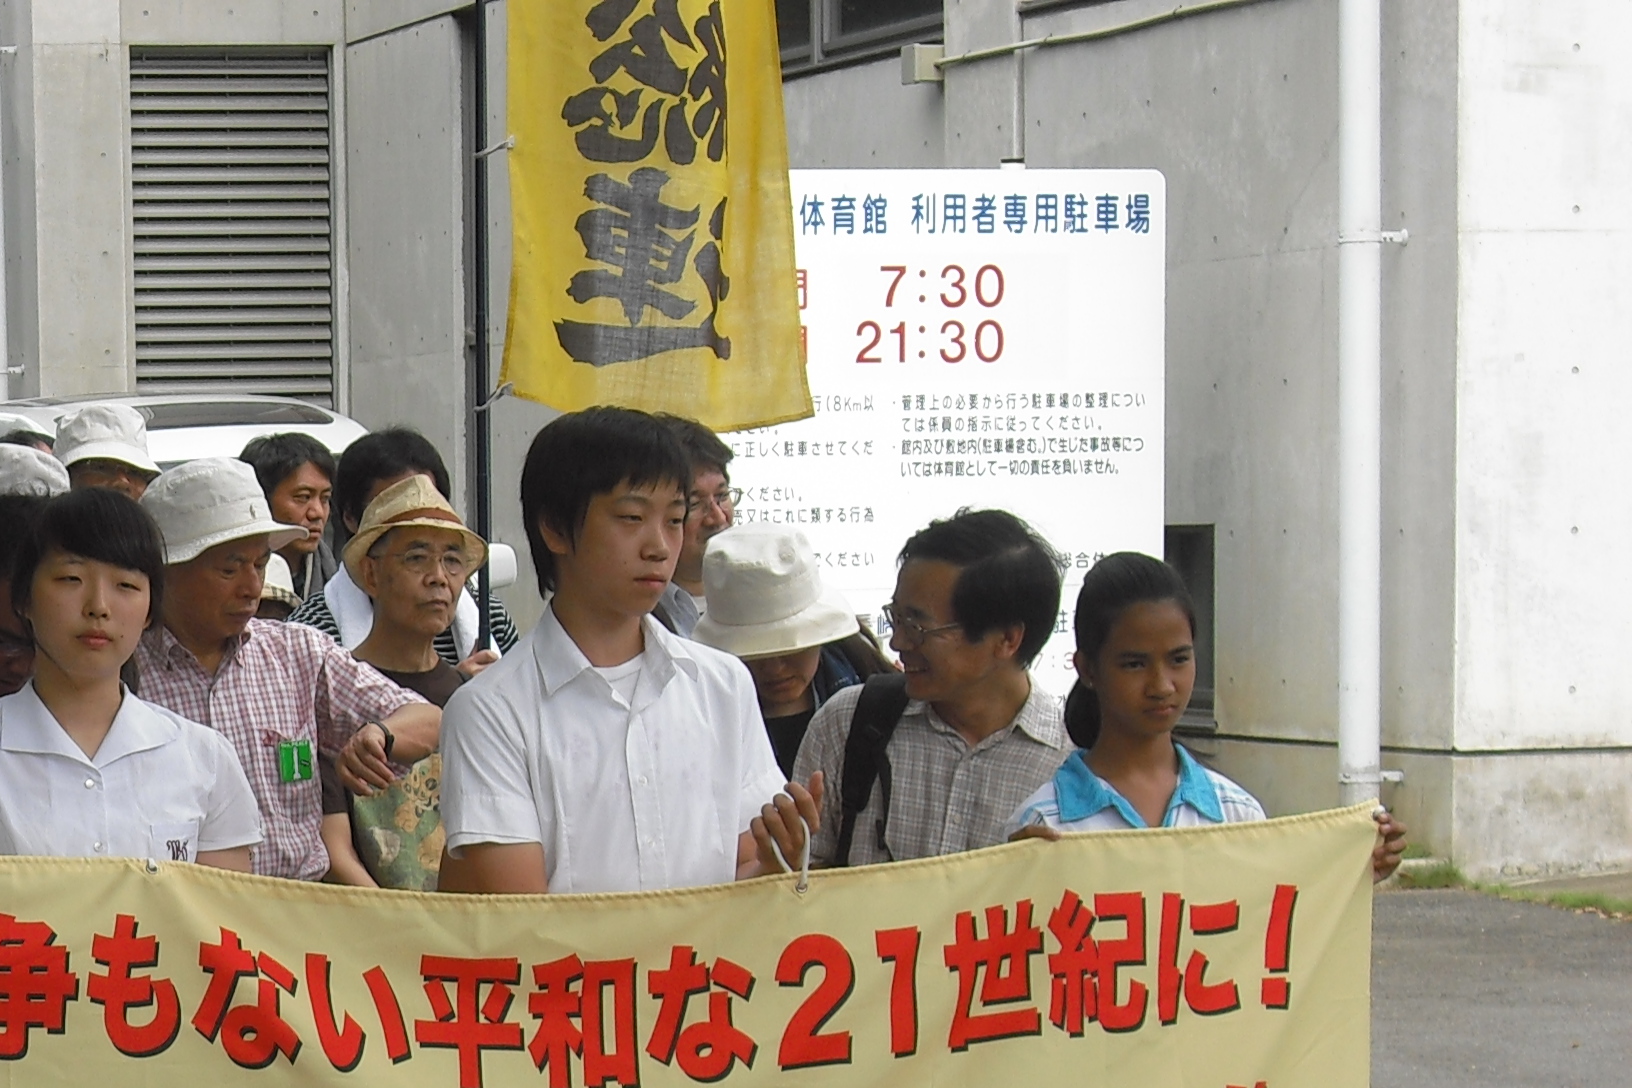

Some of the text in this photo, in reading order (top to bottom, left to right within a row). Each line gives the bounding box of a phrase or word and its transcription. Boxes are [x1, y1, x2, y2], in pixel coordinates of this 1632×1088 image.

[799, 192, 1151, 235] 体育館 利用者専用駐車場
[880, 264, 1005, 308] 7:30
[855, 319, 1005, 364] 21:30
